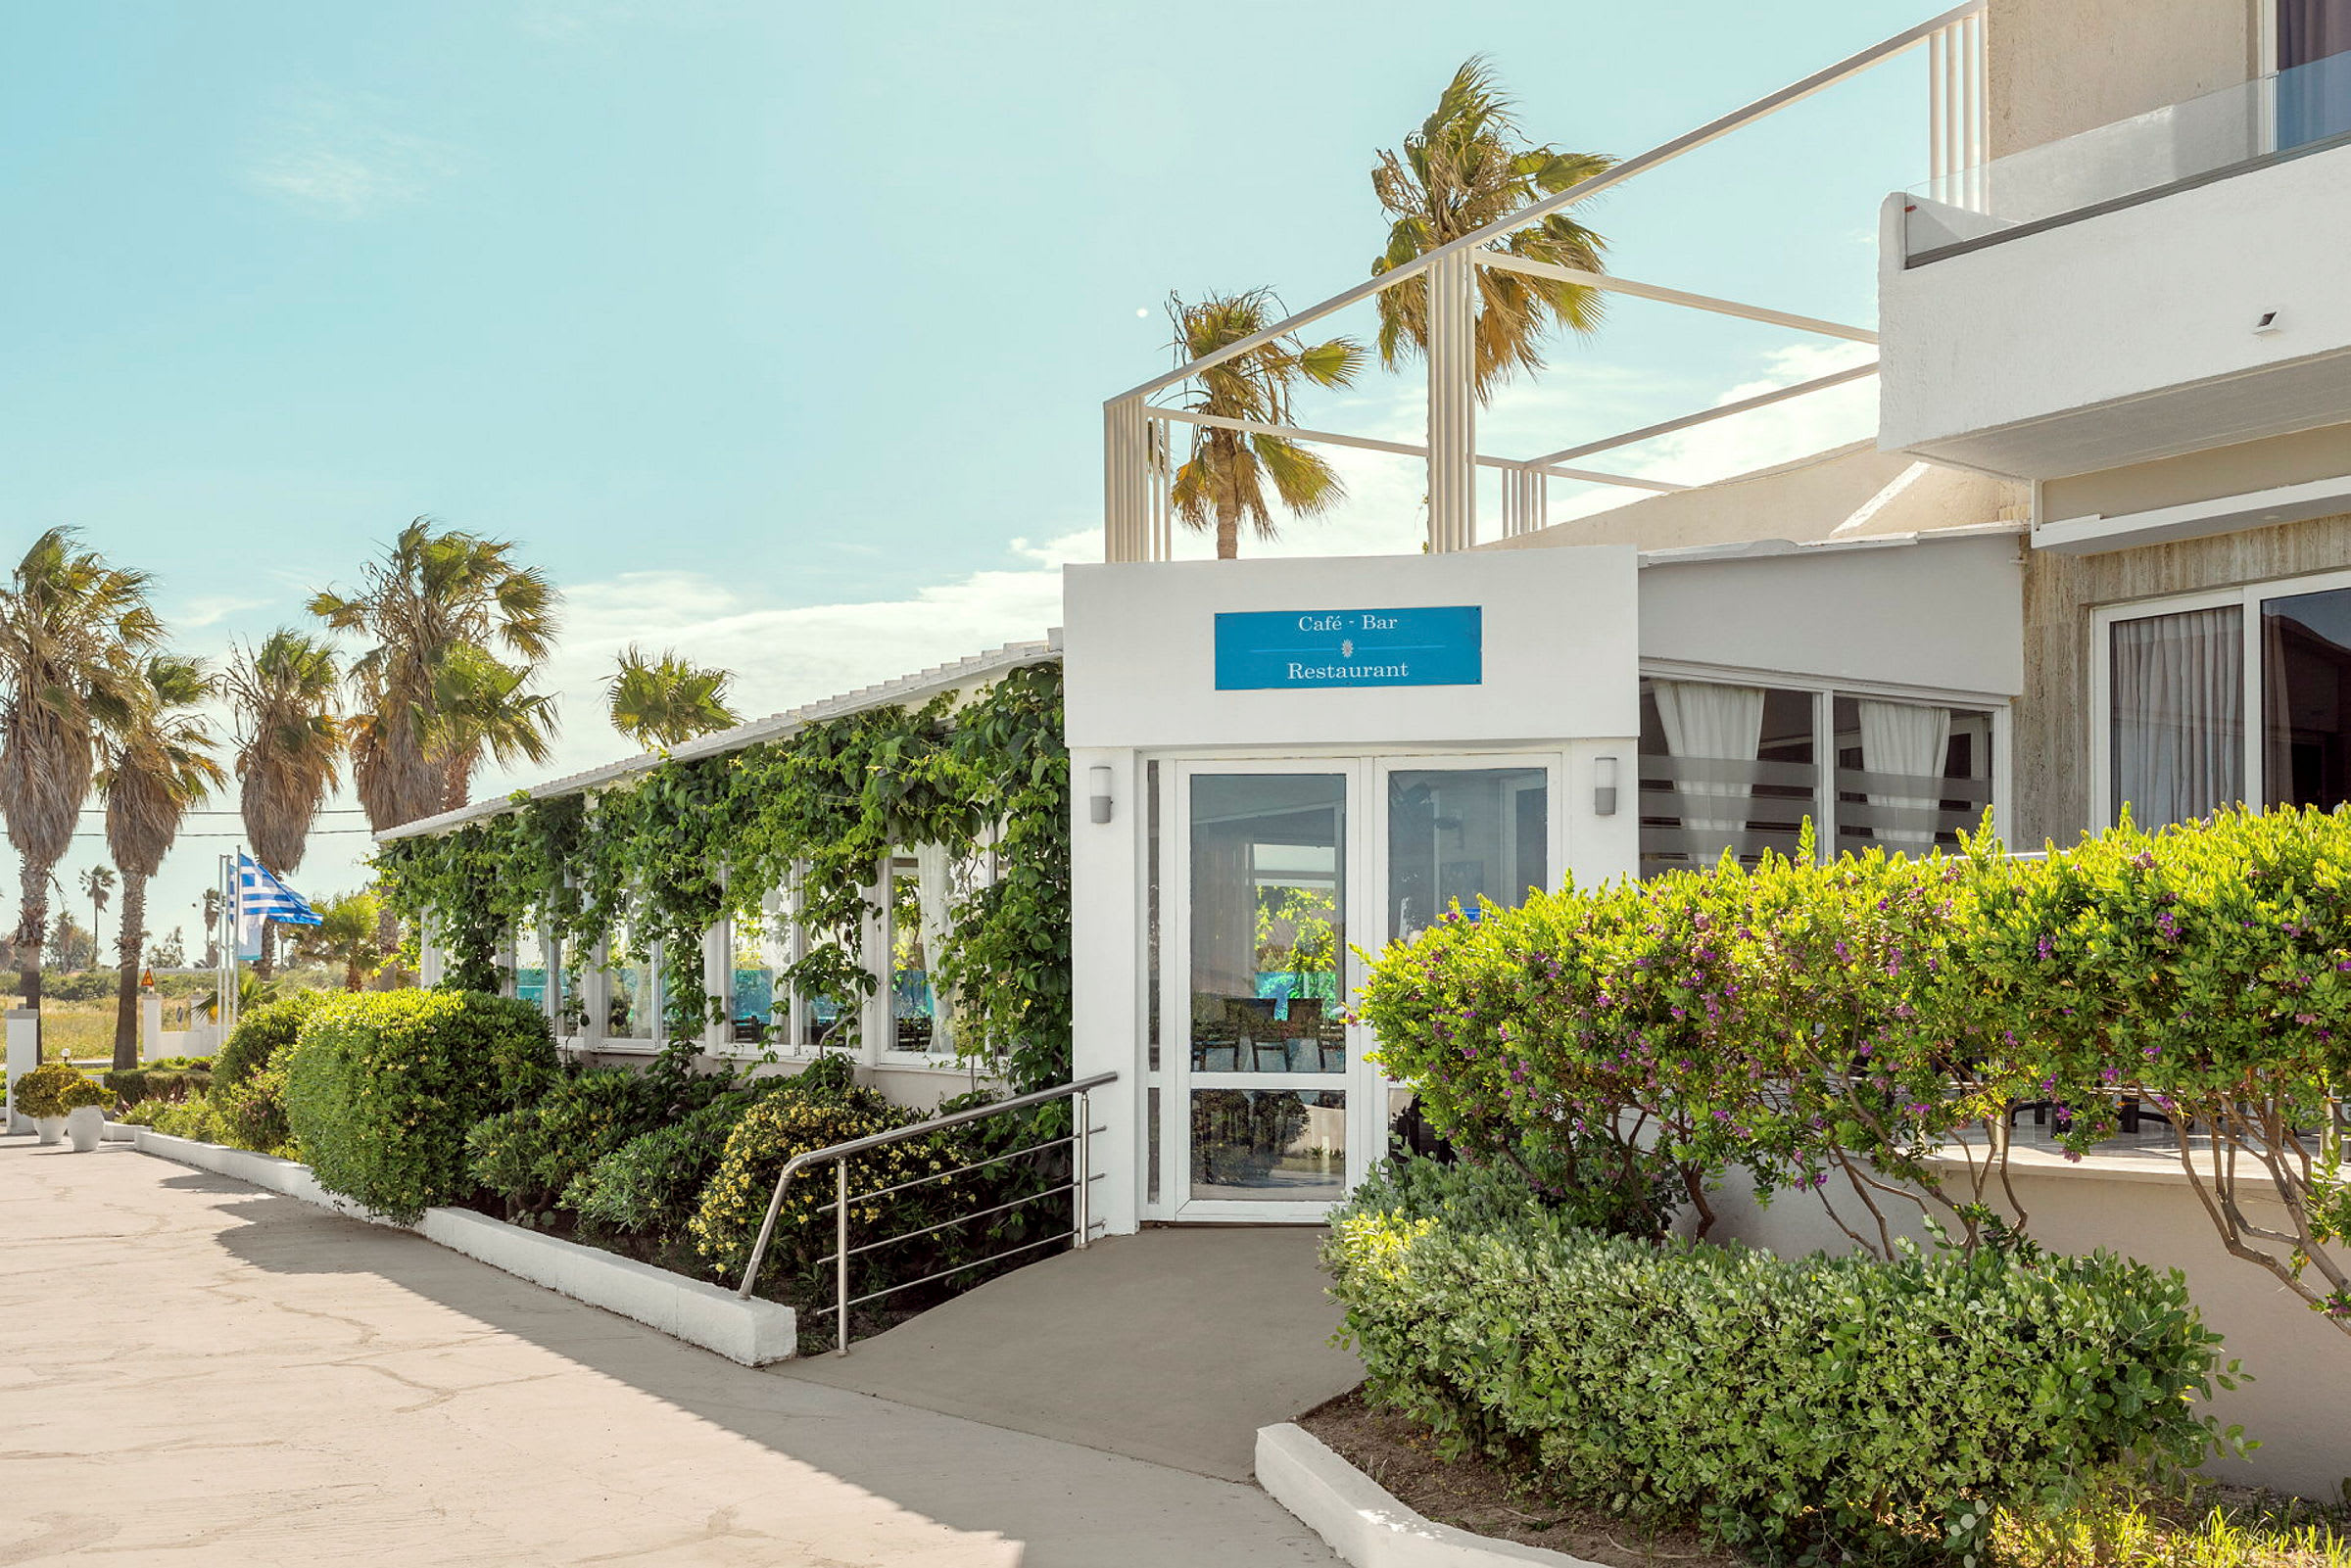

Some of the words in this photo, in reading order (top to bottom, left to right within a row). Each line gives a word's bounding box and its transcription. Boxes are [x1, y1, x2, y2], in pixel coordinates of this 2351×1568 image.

[1298, 615, 1342, 632] Café
[1362, 614, 1399, 630] Bar
[1287, 662, 1410, 680] Restaurant
